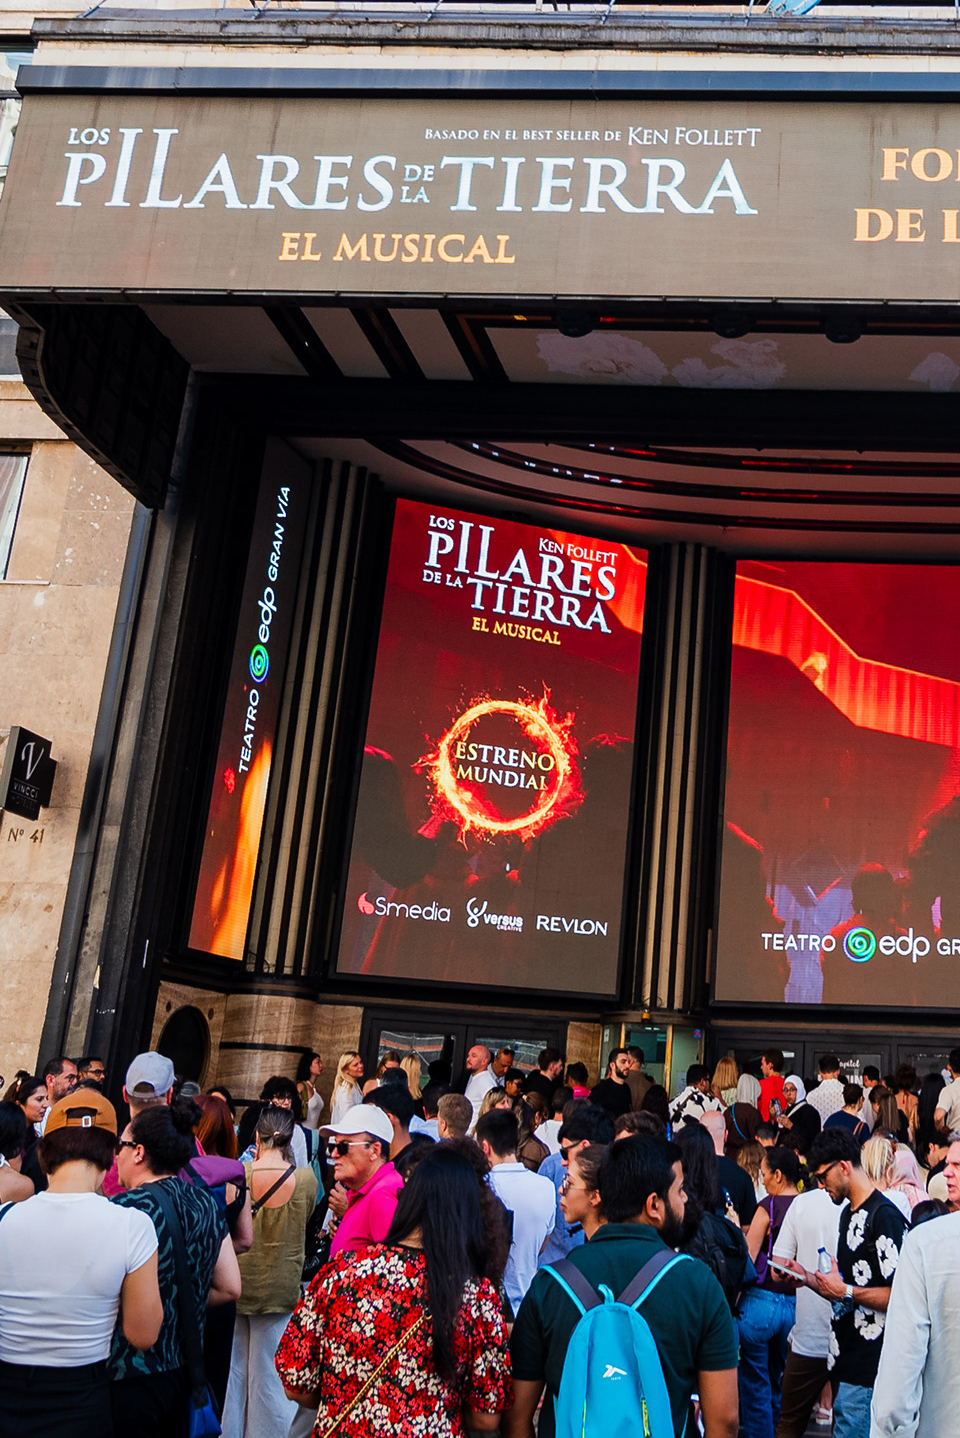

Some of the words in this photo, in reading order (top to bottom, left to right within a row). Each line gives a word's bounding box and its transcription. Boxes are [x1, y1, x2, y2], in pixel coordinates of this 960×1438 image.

[69, 127, 110, 145] LOS
[425, 129, 479, 140] BASADO
[483, 130, 500, 140] EN
[505, 130, 519, 140] EL
[523, 130, 553, 140] BEST
[556, 130, 600, 141] SELLER
[604, 130, 622, 141] DE
[628, 126, 668, 145] KEN
[674, 127, 761, 147] FOLLETT
[55, 128, 397, 211] PILARES
[404, 165, 434, 182] DE
[400, 186, 430, 204] LA
[440, 155, 759, 215] TIERRA
[854, 208, 926, 243] DE
[279, 232, 321, 262] EL
[333, 232, 515, 264] MUSICAL
[429, 515, 455, 530] LOS
[424, 520, 616, 601] PILARES
[539, 537, 564, 554] KEN
[567, 543, 618, 566] FOLLETT
[422, 569, 441, 584] DE
[446, 574, 463, 588] LA
[466, 576, 611, 634] TIERRA
[238, 688, 260, 774] TEATRO
[258, 586, 277, 643] edp
[268, 522, 286, 582] GRAN
[277, 486, 290, 518] VÍA
[472, 617, 489, 633] EL
[493, 622, 561, 645] MUSICAL
[455, 741, 555, 771] ESTRENO
[456, 765, 548, 790] MUNDIAL
[13, 782, 38, 799] VINCCI
[30, 828, 45, 843] 41
[374, 897, 451, 922] Smedia
[483, 913, 523, 927] versus
[536, 915, 608, 937] REVLON
[761, 933, 836, 952] TEATRO
[879, 928, 930, 963] edp
